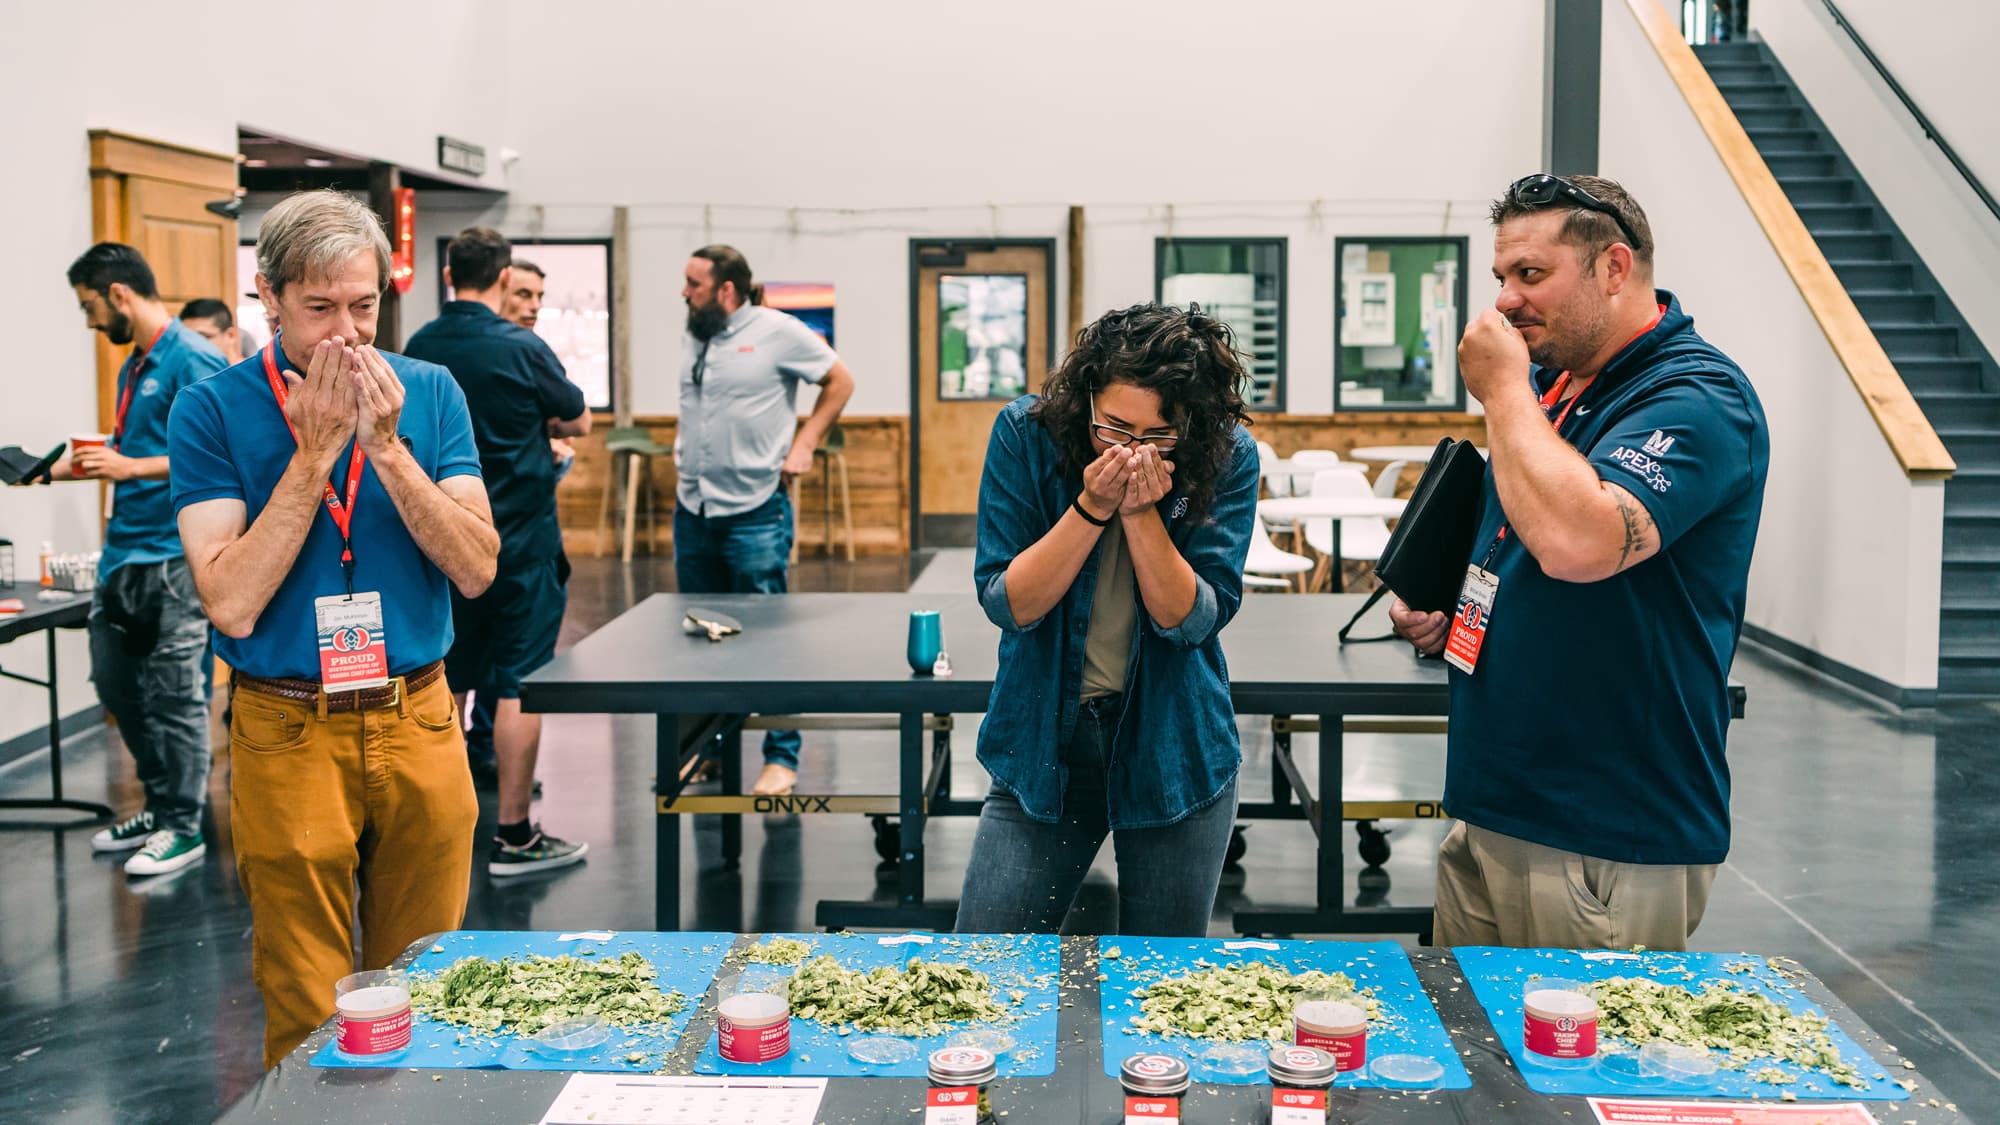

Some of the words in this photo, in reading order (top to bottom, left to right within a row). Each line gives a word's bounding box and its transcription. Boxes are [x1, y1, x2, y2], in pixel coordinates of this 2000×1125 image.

[1609, 446, 1657, 473] APEX
[1455, 626, 1477, 645] PROUD
[331, 653, 376, 666] PROUD
[753, 796, 831, 813] ONYX
